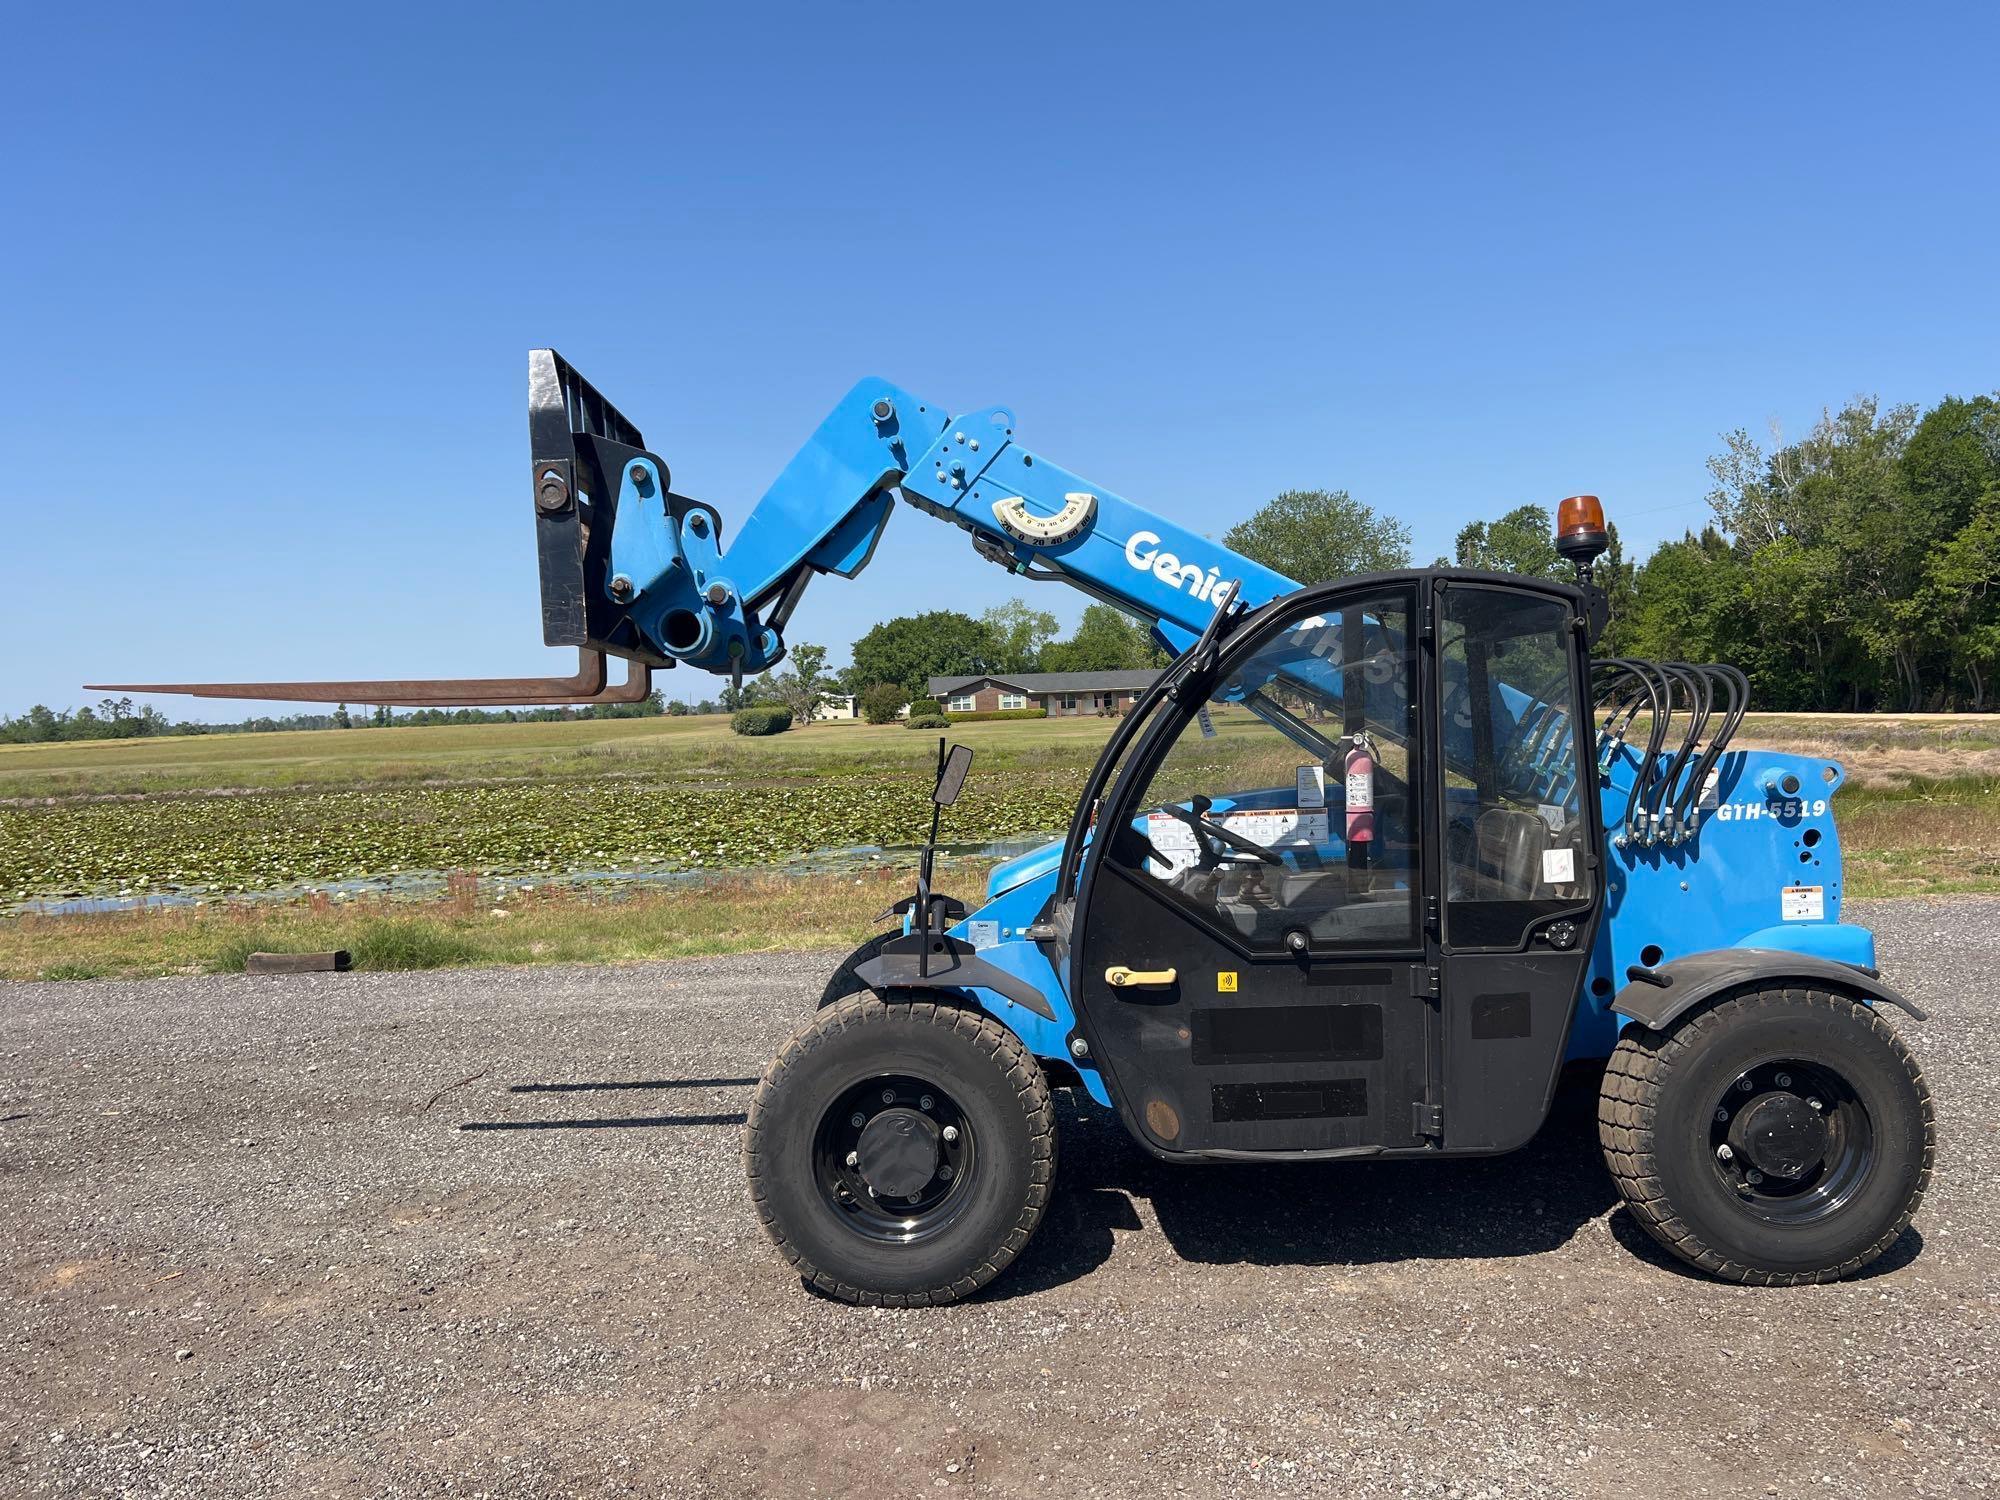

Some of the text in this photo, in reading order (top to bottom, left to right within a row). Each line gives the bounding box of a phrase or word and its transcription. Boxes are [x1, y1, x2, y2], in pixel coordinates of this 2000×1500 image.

[1018, 533, 1025, 541] 0
[1050, 537, 1063, 545] 40
[1067, 528, 1079, 539] 60
[1080, 515, 1091, 527] 80
[1717, 800, 1826, 821] GTH-5519
